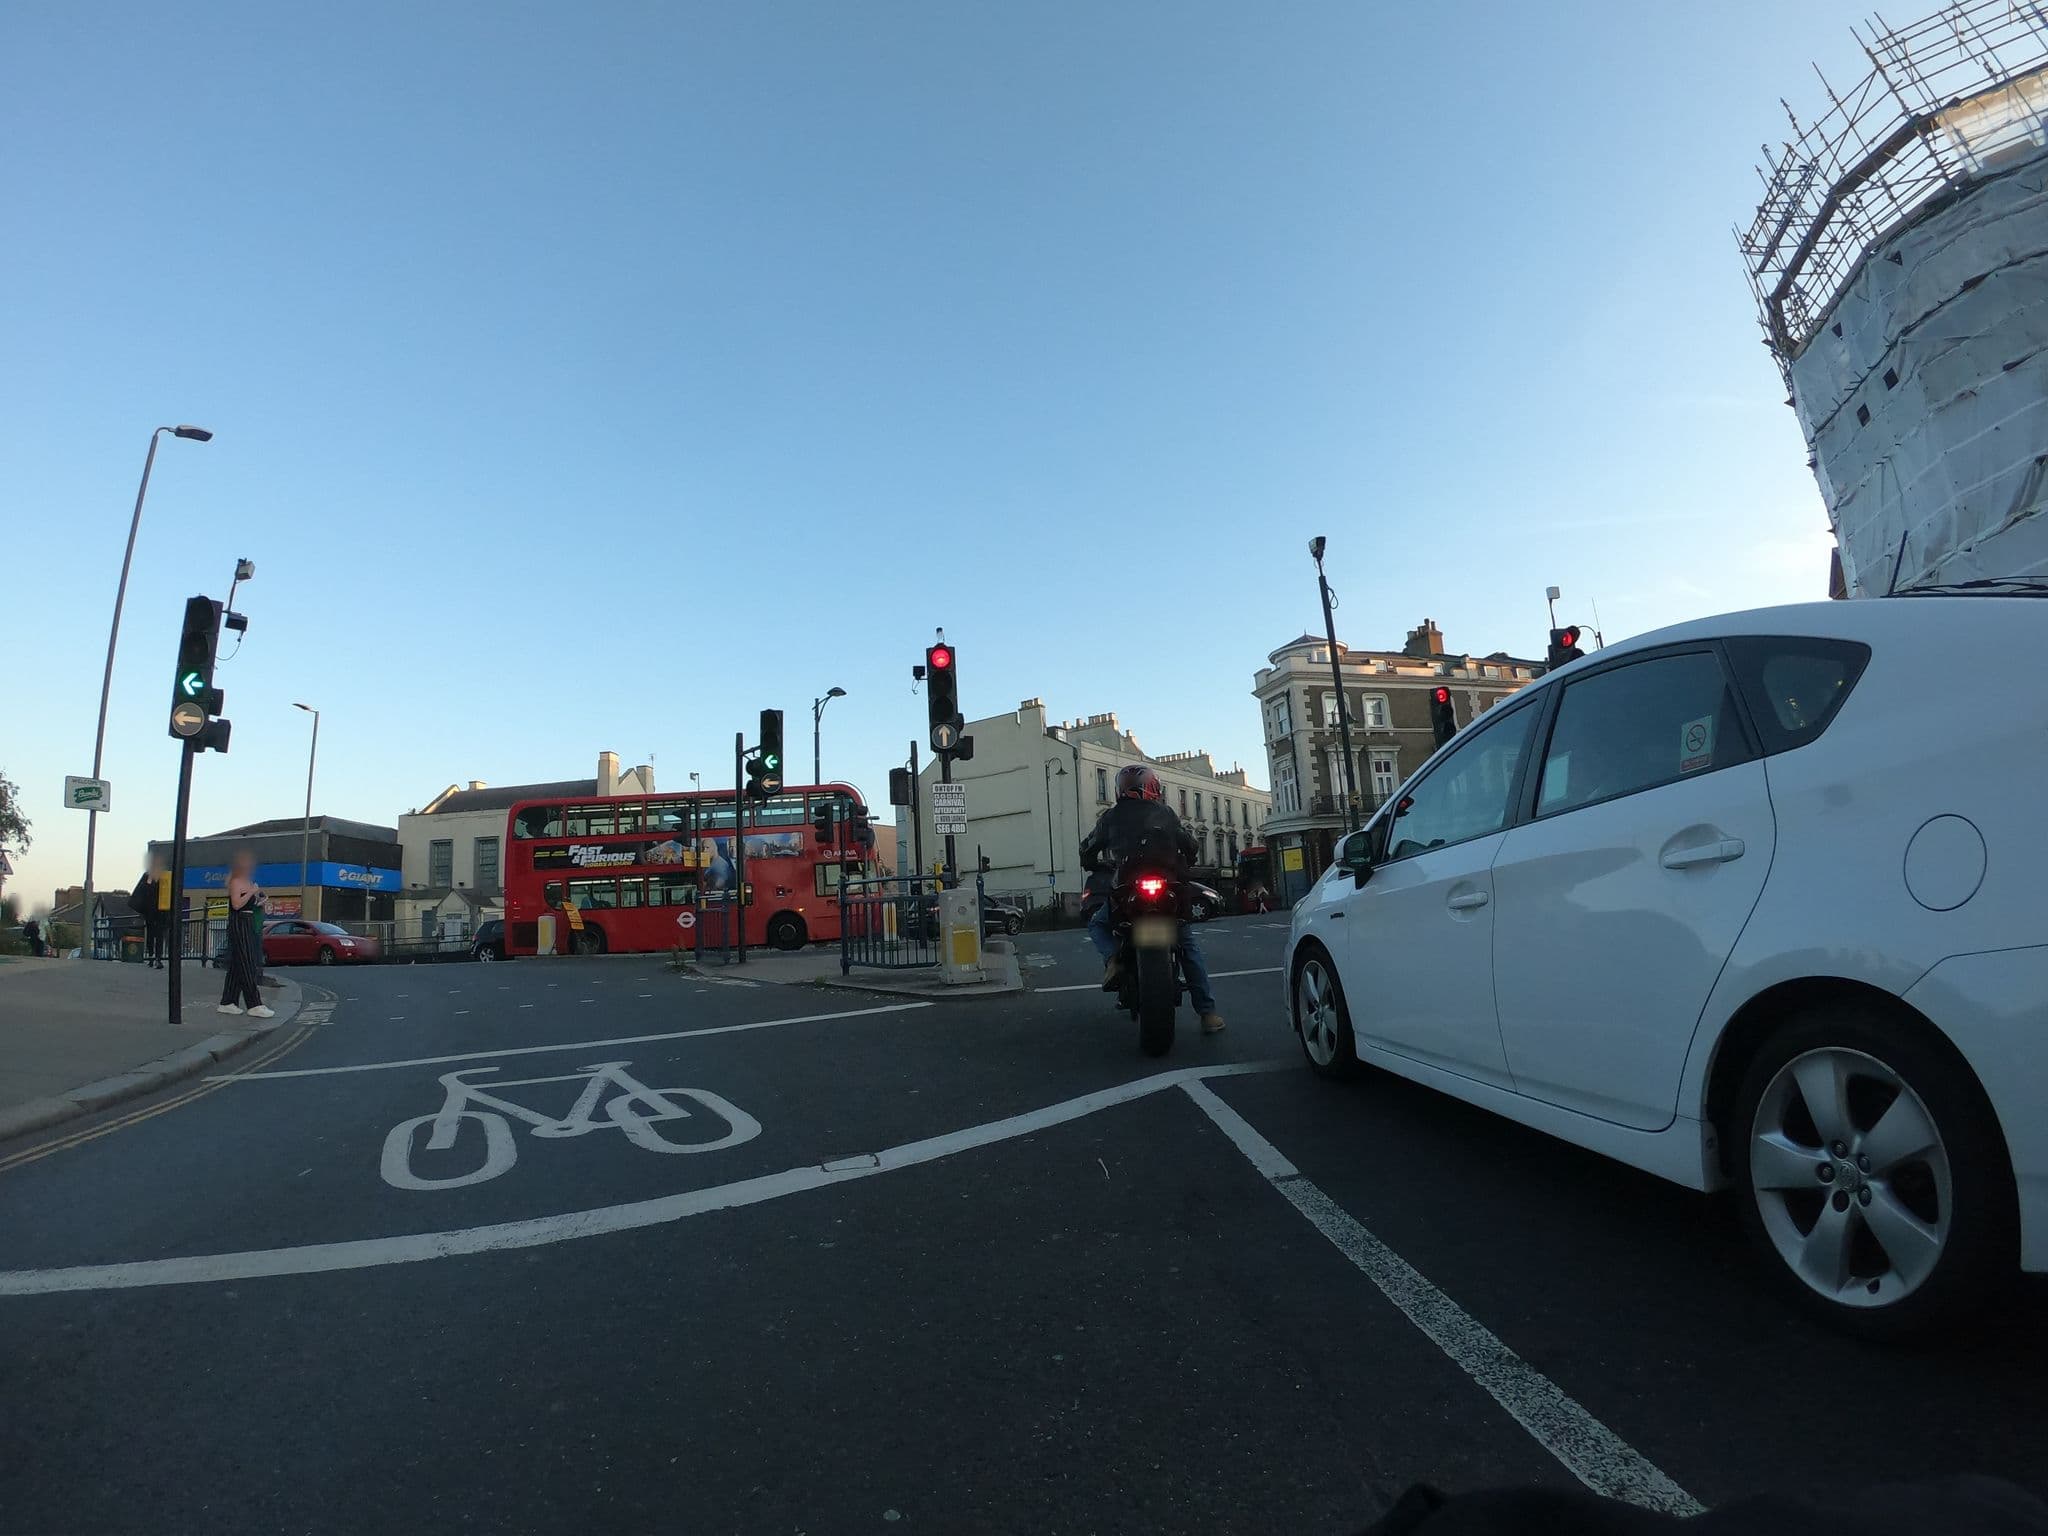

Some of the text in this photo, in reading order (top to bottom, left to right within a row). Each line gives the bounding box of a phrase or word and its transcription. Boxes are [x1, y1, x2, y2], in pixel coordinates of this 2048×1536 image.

[568, 845, 604, 856] FAST
[580, 852, 636, 866] FURIOUS
[348, 871, 384, 883] GIANT
